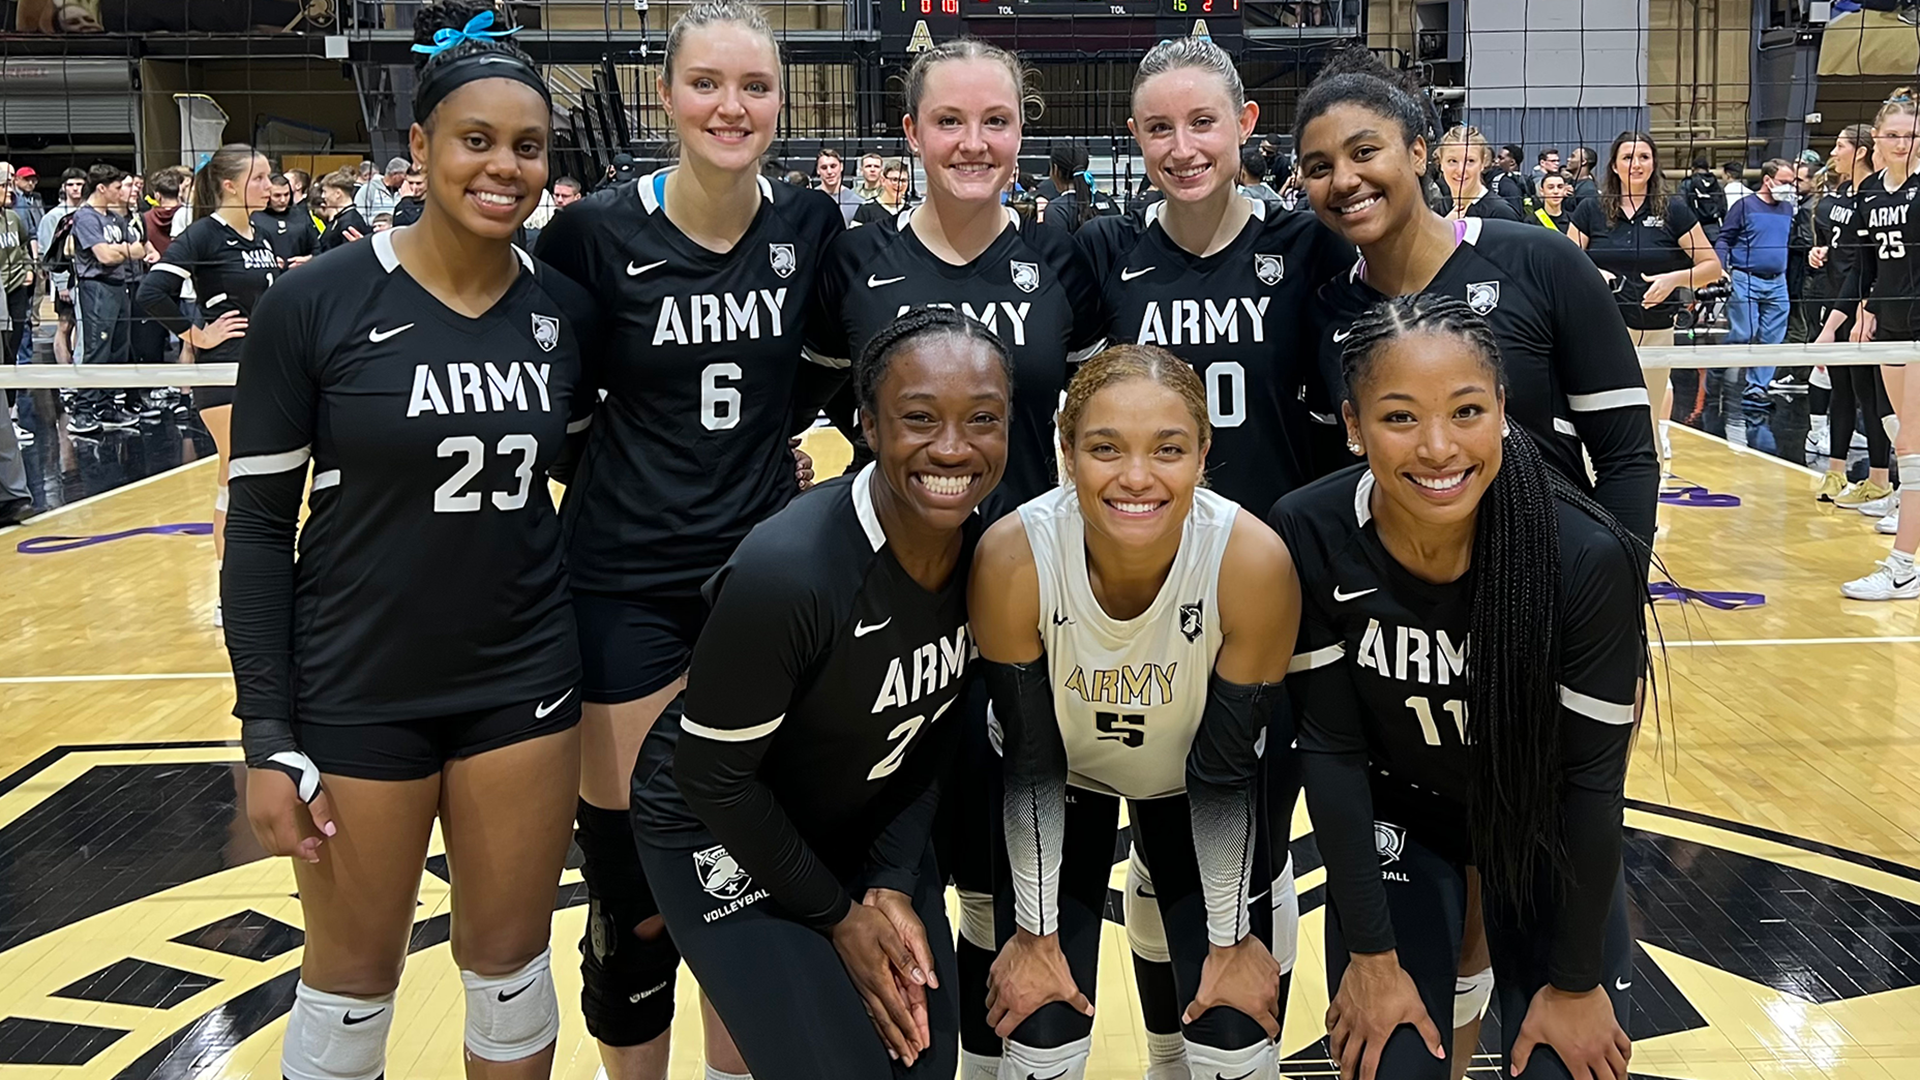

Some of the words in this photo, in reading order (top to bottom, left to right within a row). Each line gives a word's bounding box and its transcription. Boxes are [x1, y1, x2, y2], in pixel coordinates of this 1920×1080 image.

[998, 6, 1014, 15] TOL
[1110, 6, 1126, 14] TOL
[905, 19, 935, 52] A
[1830, 204, 1854, 225] ARMY
[1868, 203, 1910, 228] ARMY
[1831, 225, 1841, 249] 2
[1875, 230, 1906, 259] 25
[652, 287, 787, 346] ARMY
[897, 301, 1032, 346] MY
[1137, 296, 1271, 346] ARMY
[406, 361, 551, 418] ARMY
[700, 362, 743, 431] 6
[1187, 361, 1246, 428] 0
[433, 434, 539, 512] 23
[1357, 617, 1471, 686] ARM
[1064, 661, 1178, 706] ARMY
[1095, 711, 1146, 748] 5
[703, 888, 771, 923] VOLLEYBAL
